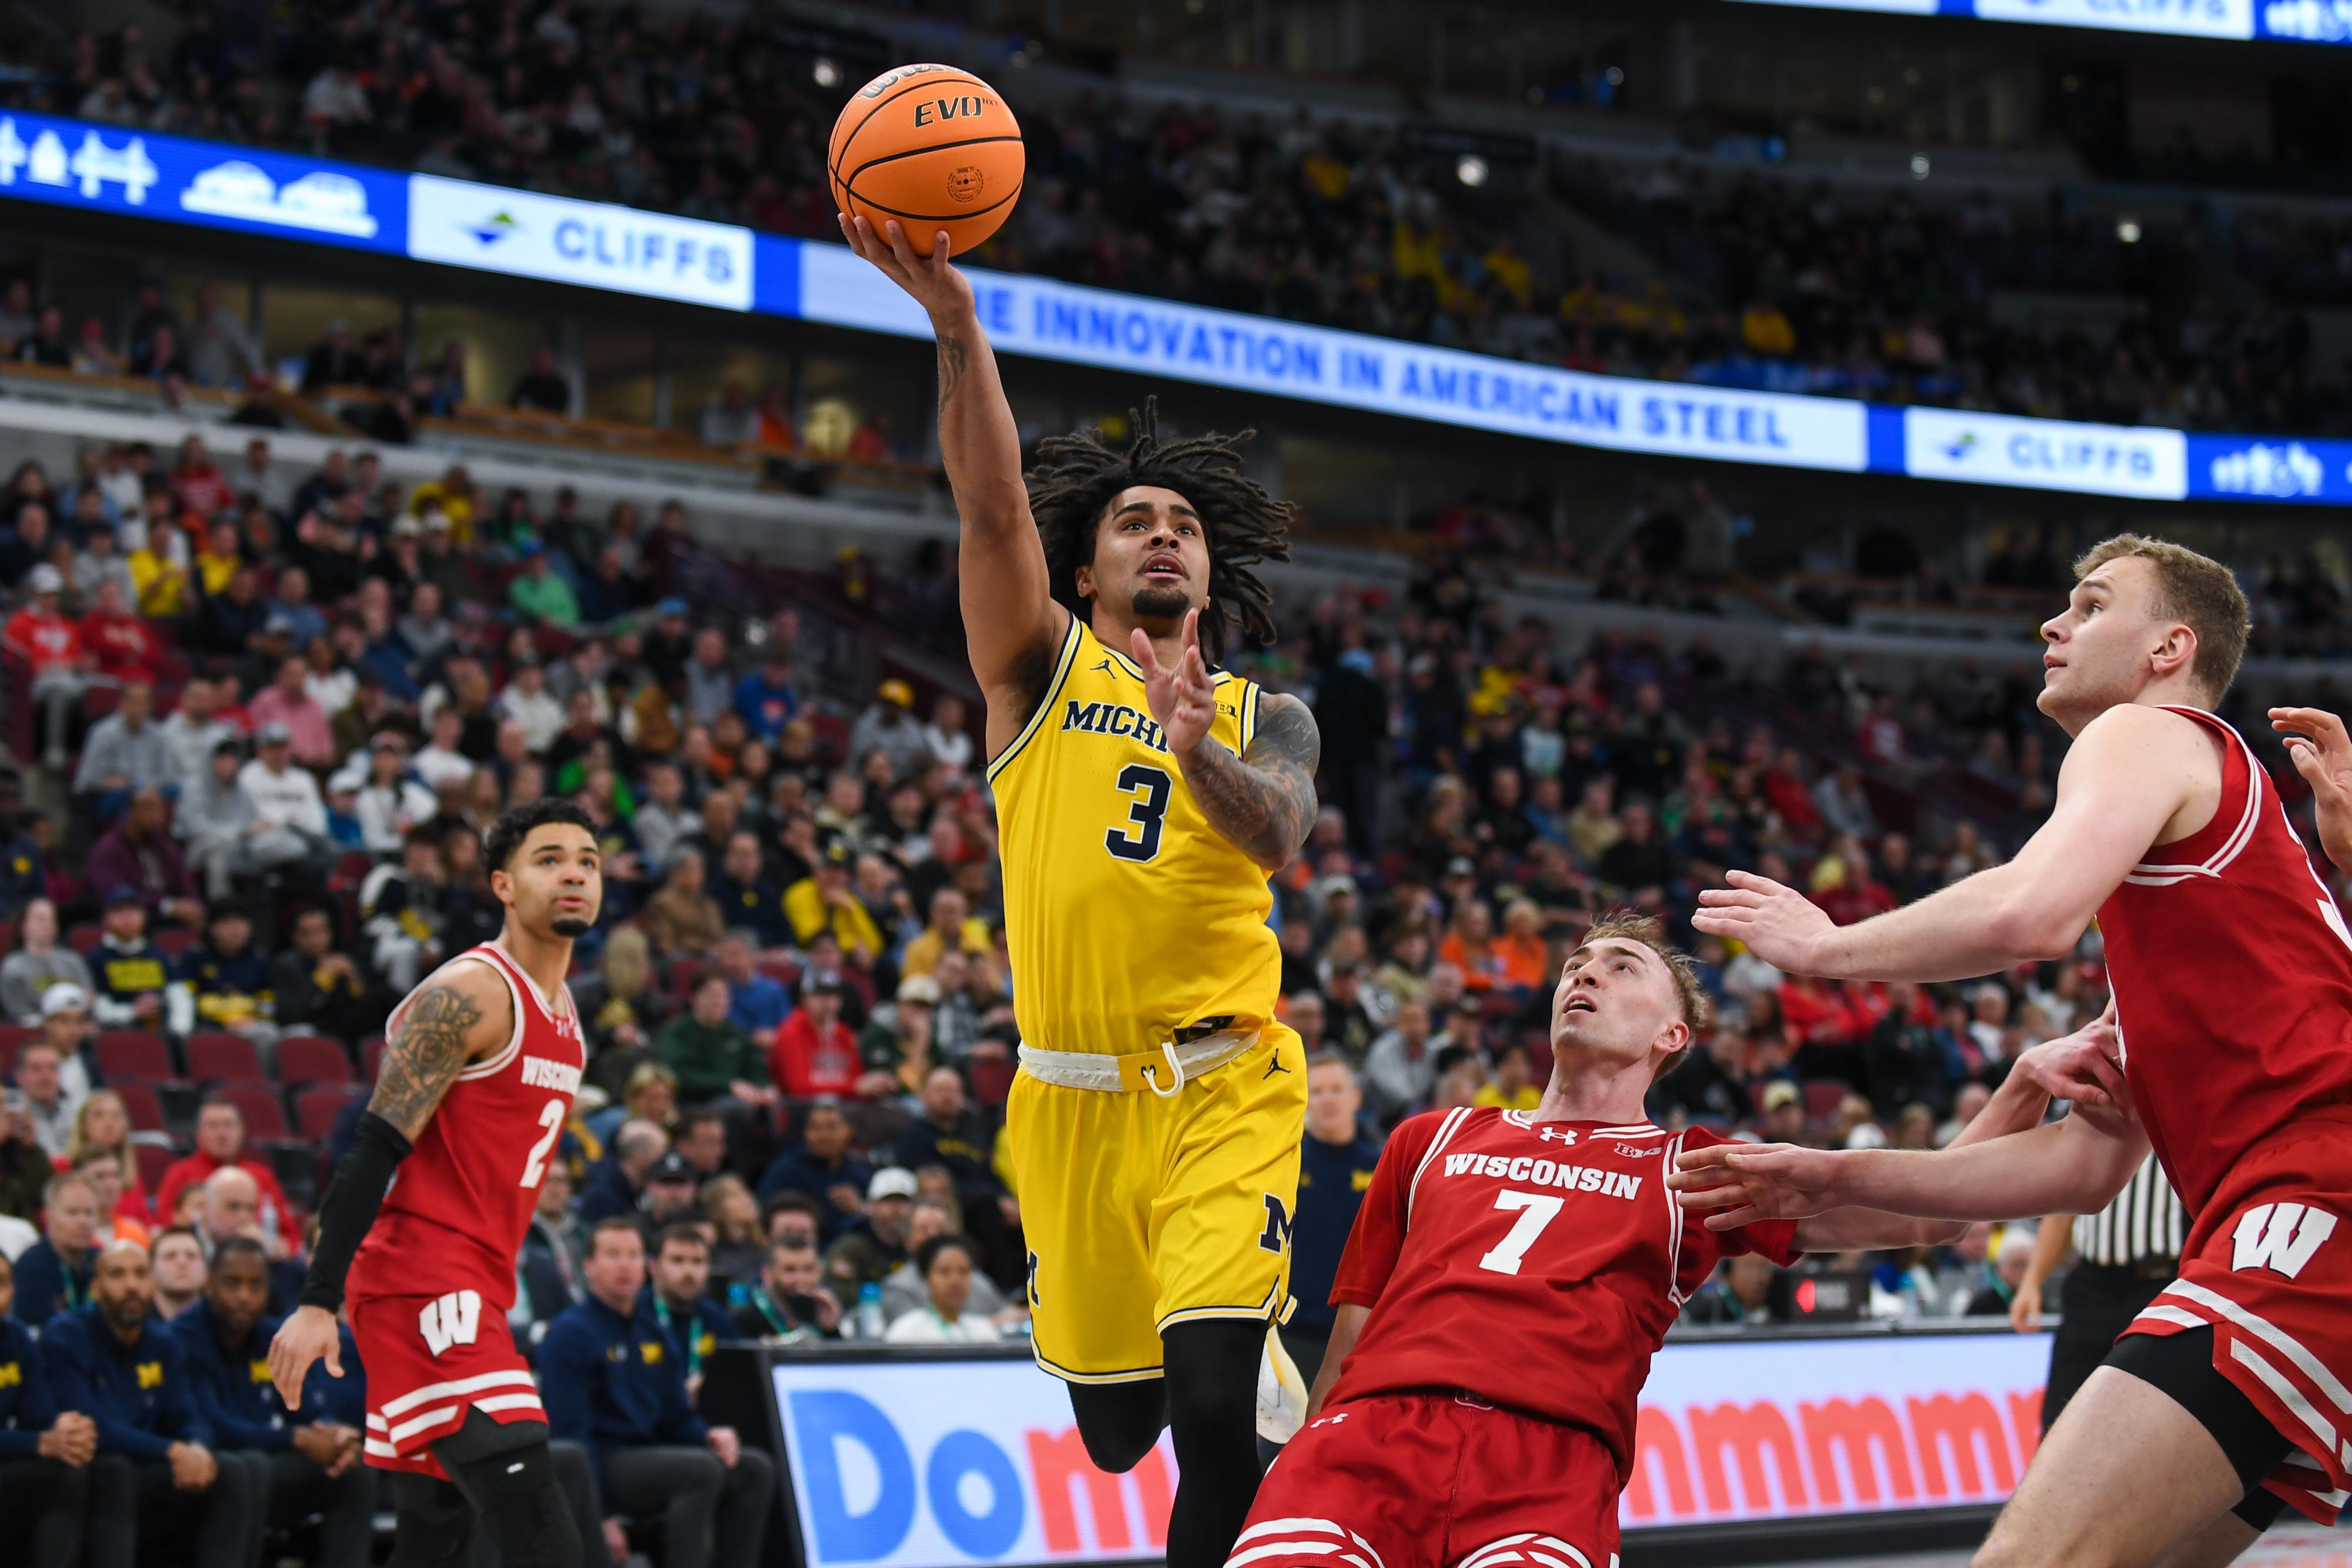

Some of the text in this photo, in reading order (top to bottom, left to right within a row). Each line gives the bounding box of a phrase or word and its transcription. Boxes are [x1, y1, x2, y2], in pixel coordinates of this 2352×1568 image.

[914, 96, 981, 128] EVO
[555, 218, 734, 283] CLIFFS
[1033, 296, 1321, 382] INNOVATION
[1340, 348, 1381, 389] IN
[1400, 361, 1621, 430] AMERICAN
[1642, 397, 1788, 448] STEEL
[1061, 700, 1242, 760] MICHI
[1103, 763, 1173, 864] 3
[519, 1098, 565, 1188] 2
[1444, 1153, 1643, 1200] WISCONSIN
[1479, 1188, 1565, 1276] 7
[2231, 1202, 2338, 1279] W
[418, 1289, 481, 1358] W
